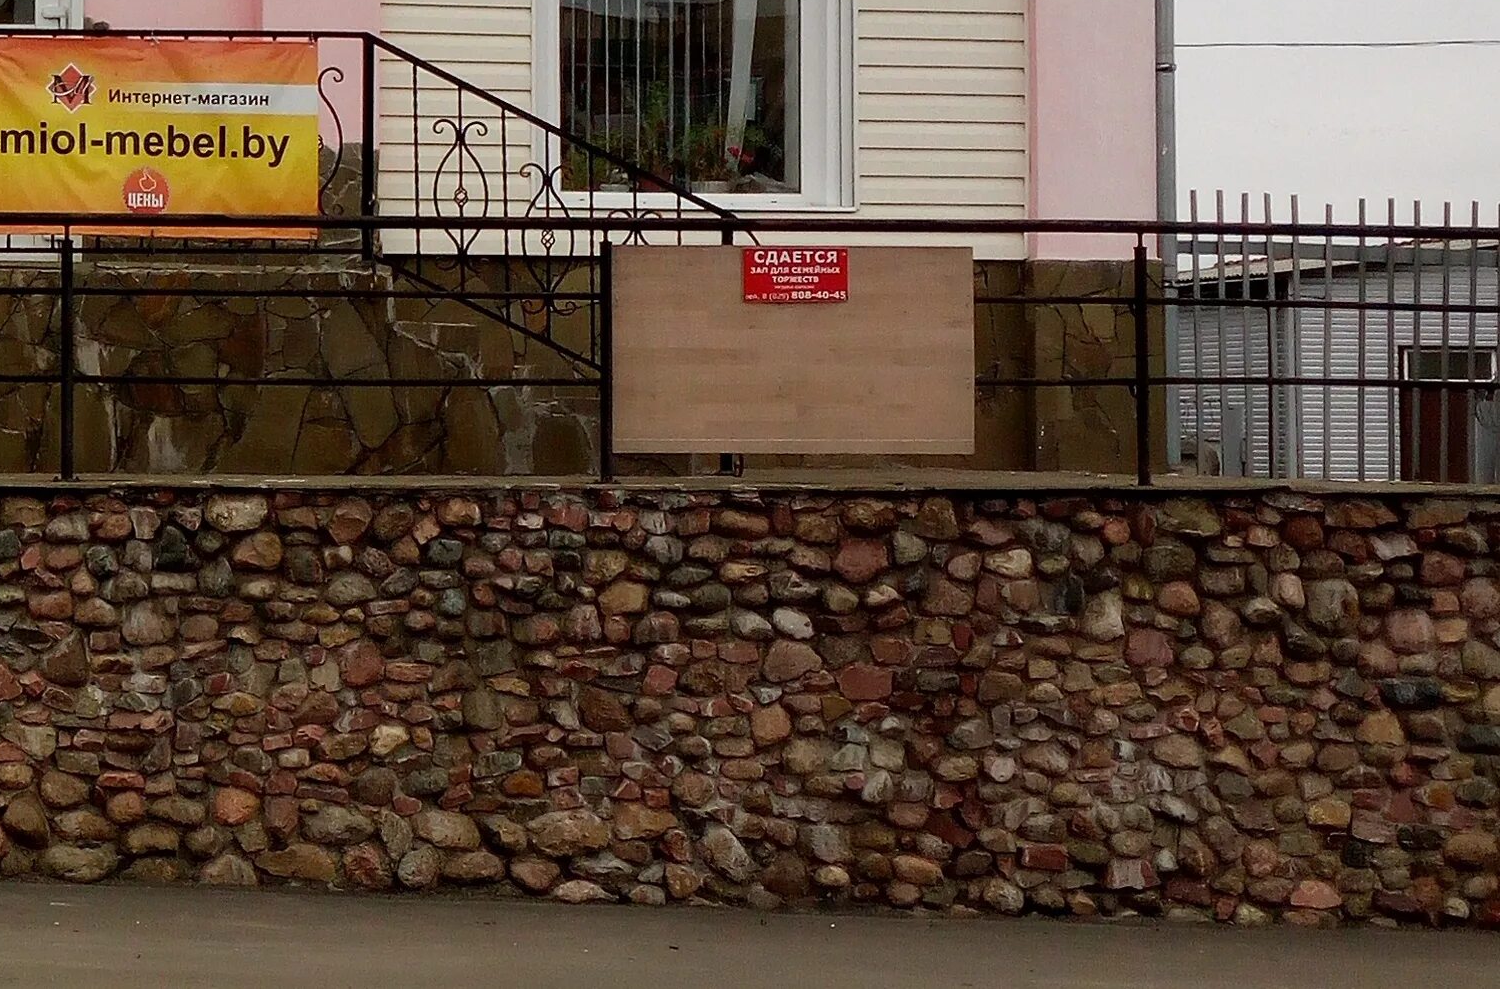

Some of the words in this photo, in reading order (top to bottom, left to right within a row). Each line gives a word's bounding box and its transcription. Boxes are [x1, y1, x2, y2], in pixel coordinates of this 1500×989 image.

[108, 88, 270, 107] Интернет-магазин
[0, 121, 291, 168] miol-mebel.by
[127, 191, 164, 209] ЦЕНЫ
[753, 250, 838, 265] СДАЕТСЯ
[769, 266, 790, 275] ДЛЯ
[791, 291, 846, 300] 808-40-45
